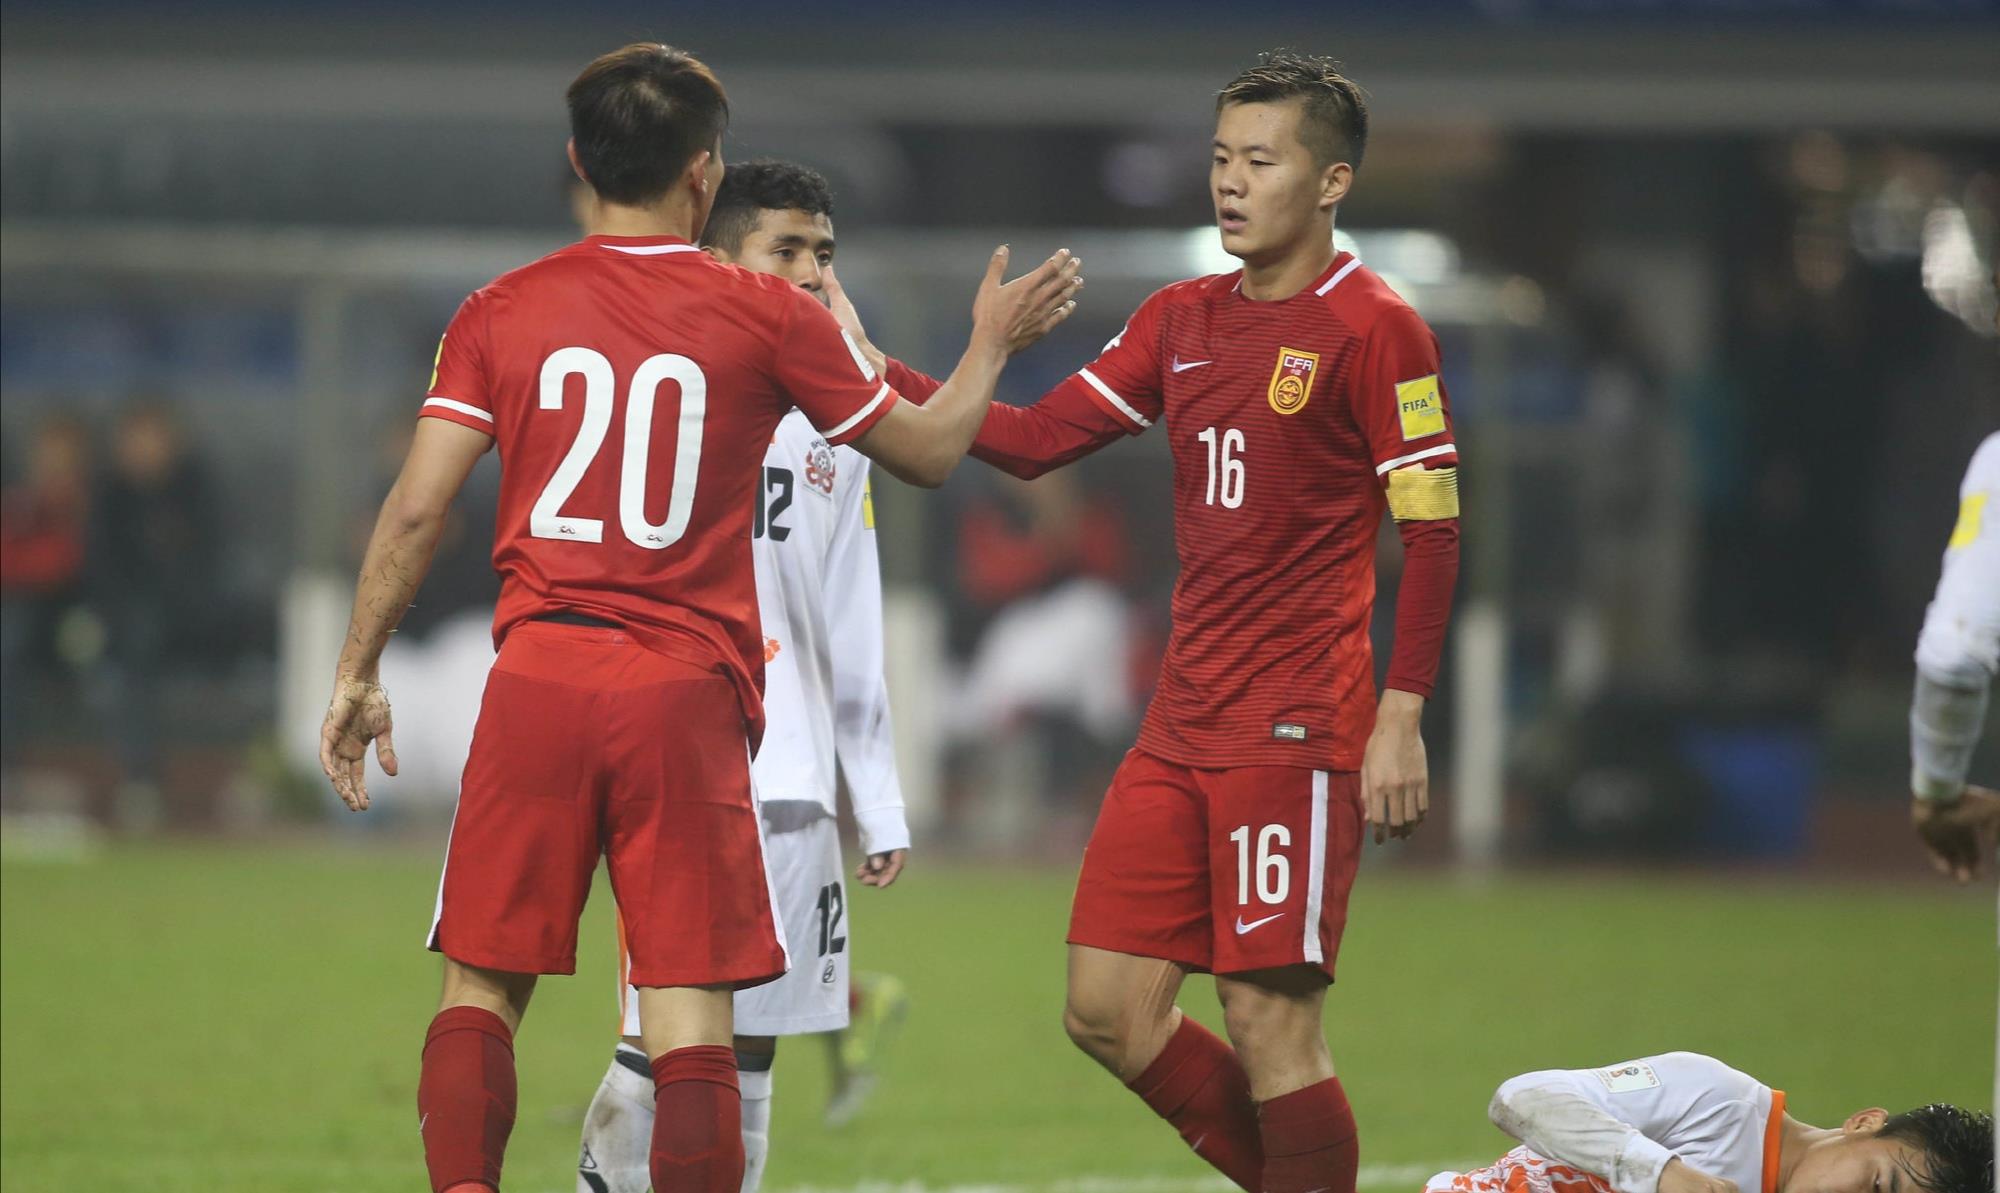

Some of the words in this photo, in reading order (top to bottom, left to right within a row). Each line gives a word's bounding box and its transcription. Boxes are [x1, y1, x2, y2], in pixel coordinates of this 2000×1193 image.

[1284, 355, 1313, 371] CFA
[1402, 398, 1428, 412] FIFA
[530, 346, 707, 550] 20
[1198, 426, 1245, 509] 16
[1230, 823, 1291, 905] 16
[816, 881, 846, 958] 12
